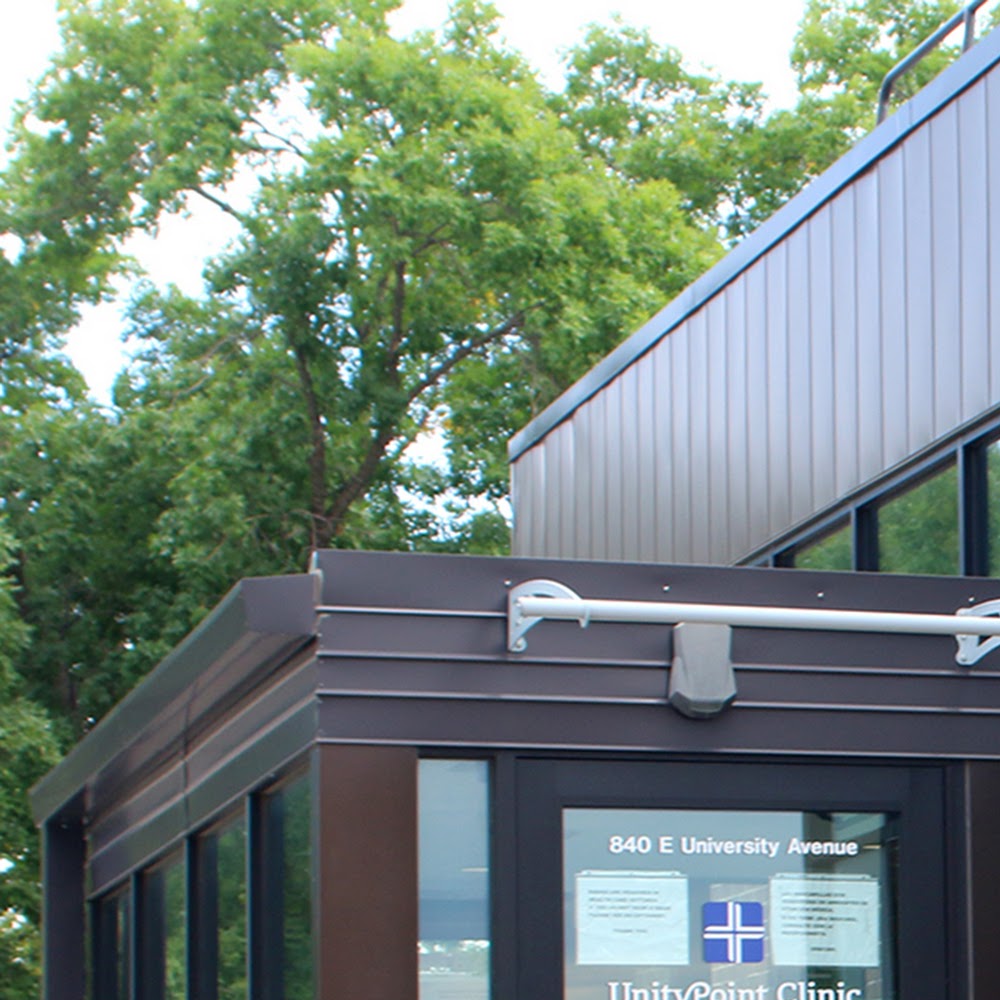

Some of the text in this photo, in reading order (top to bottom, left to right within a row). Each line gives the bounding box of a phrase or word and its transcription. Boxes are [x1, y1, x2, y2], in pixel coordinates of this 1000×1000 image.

[609, 836, 859, 857] 840 E University Avenue
